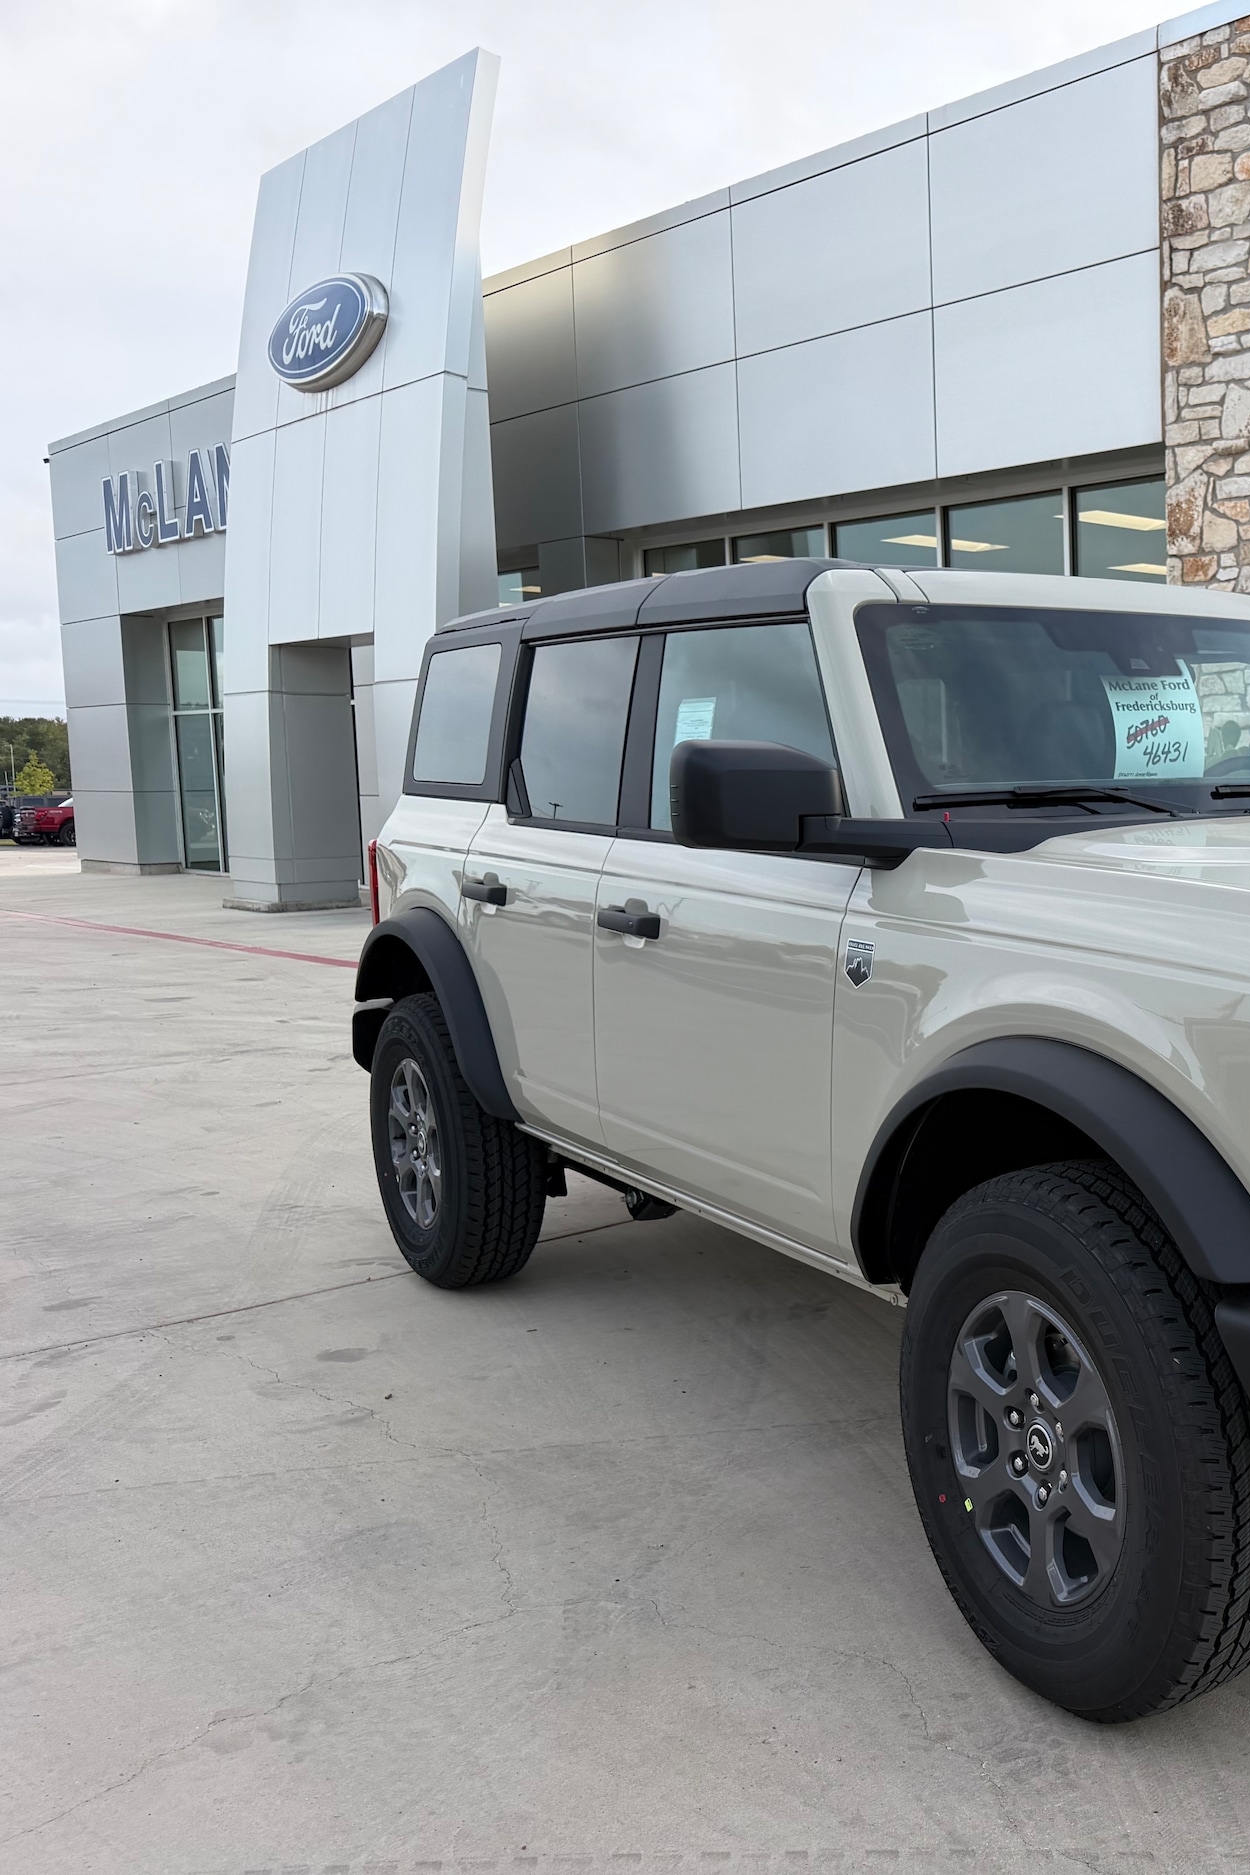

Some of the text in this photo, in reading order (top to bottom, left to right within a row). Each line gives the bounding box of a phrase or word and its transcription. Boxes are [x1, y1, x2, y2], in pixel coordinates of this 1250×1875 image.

[282, 297, 341, 365] Ford
[1108, 679, 1190, 691] McLane Ford
[1149, 693, 1158, 701] of
[1115, 701, 1196, 713] Fredericksburg
[1143, 741, 1188, 767] 46431
